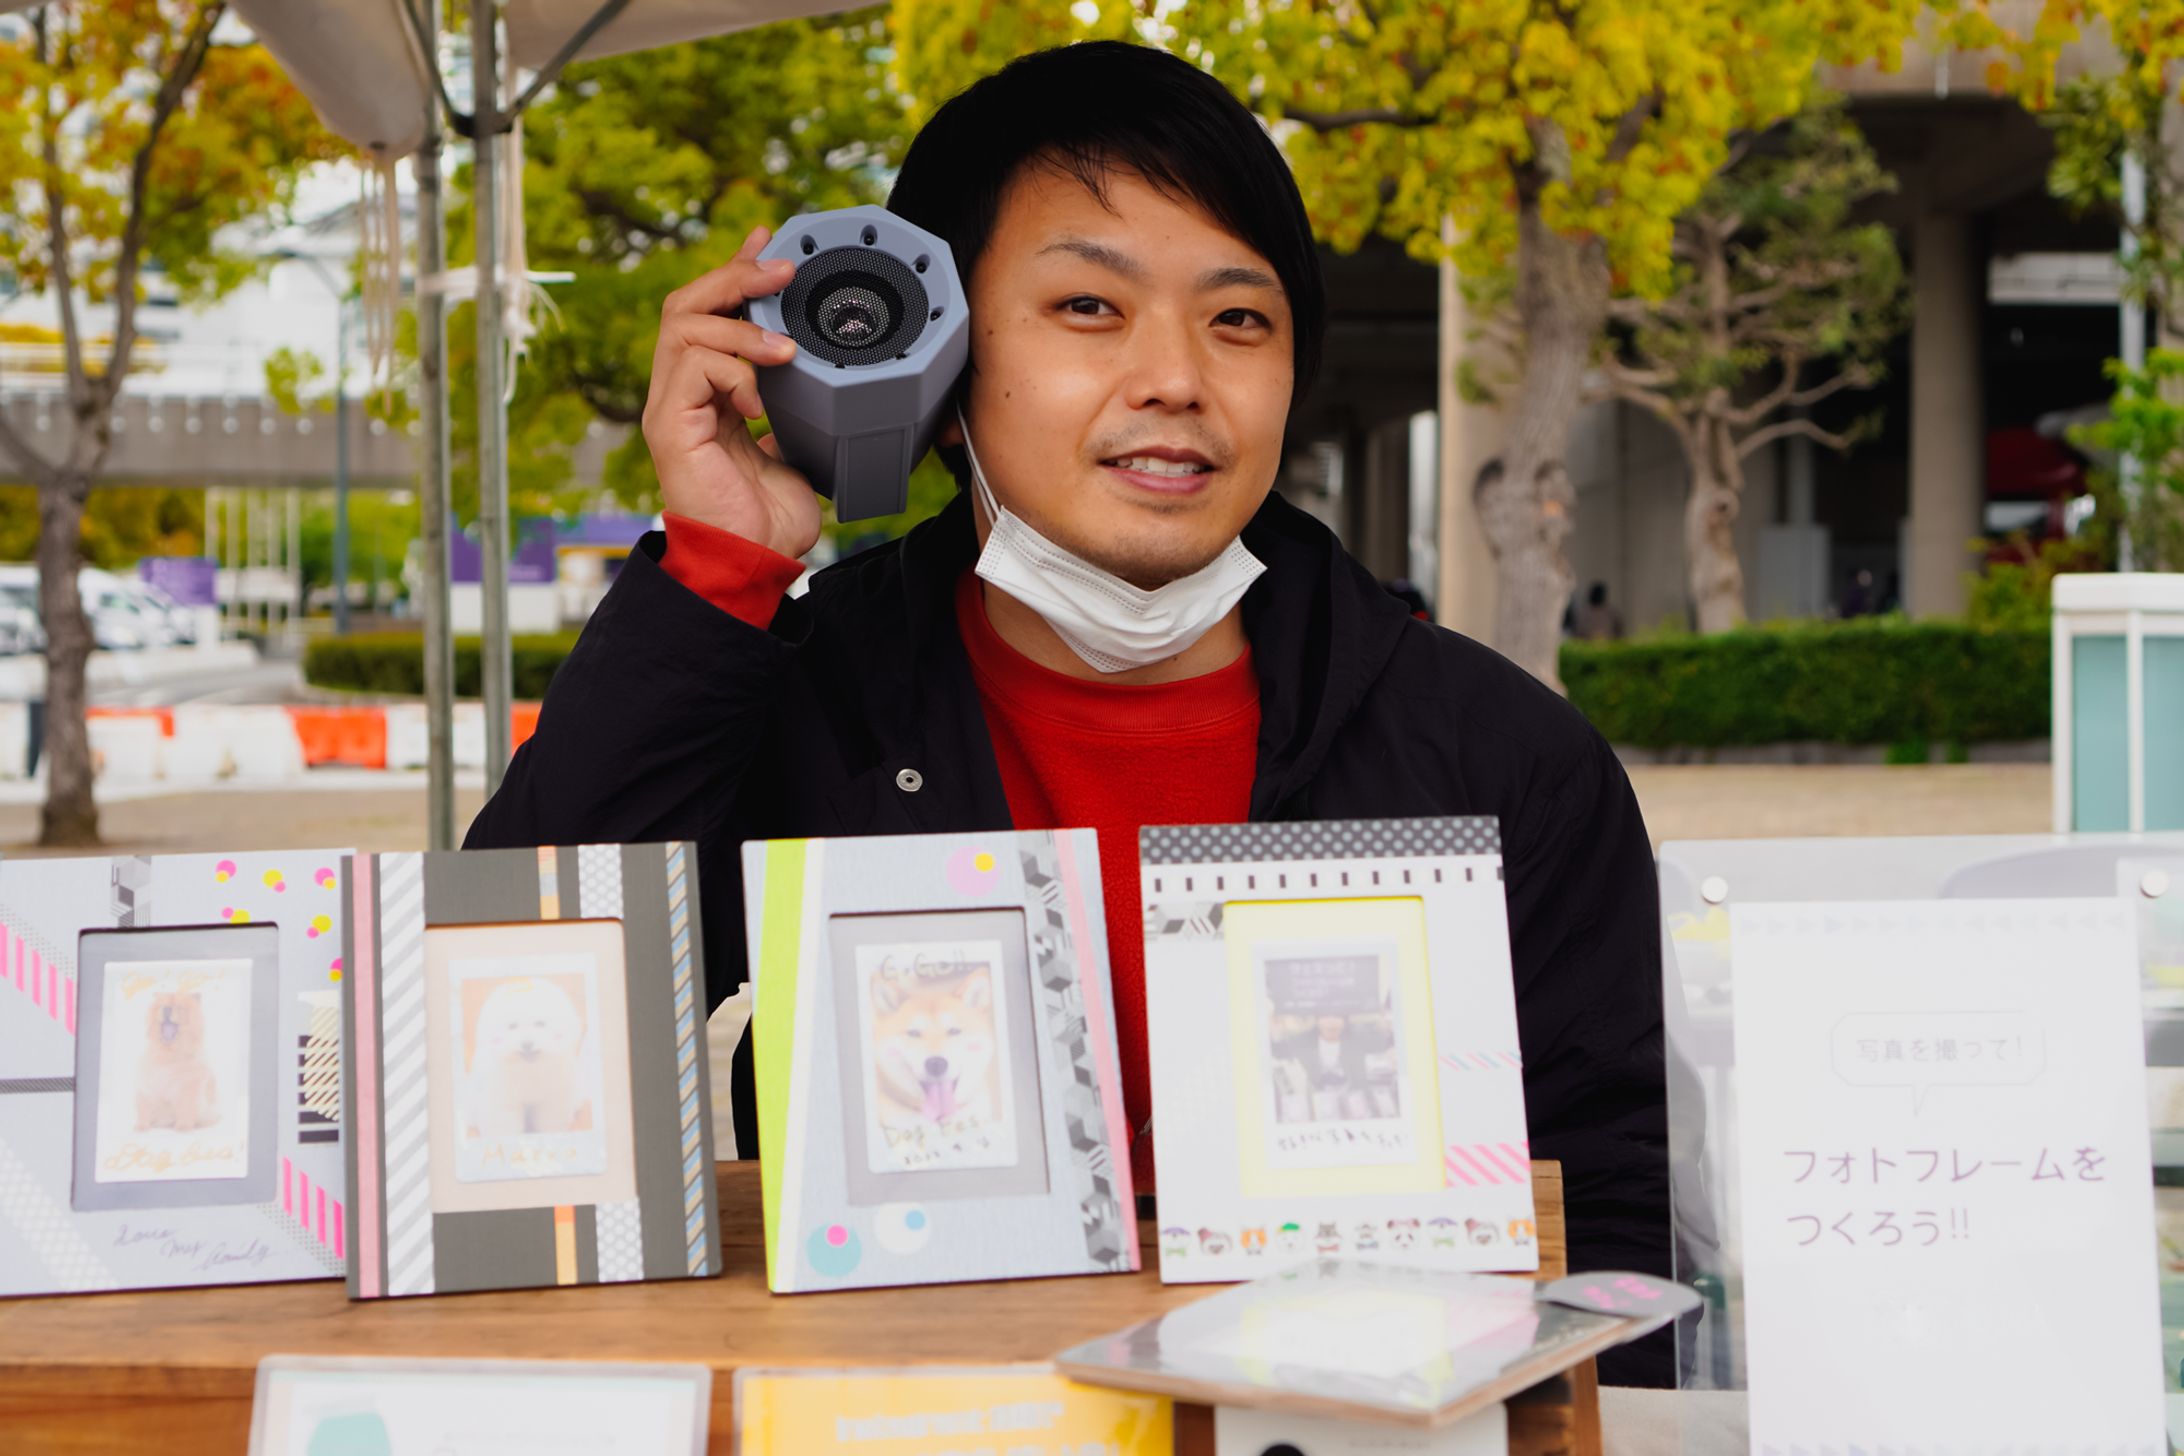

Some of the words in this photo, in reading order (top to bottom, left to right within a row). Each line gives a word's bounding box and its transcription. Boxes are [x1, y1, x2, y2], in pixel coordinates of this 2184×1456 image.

[1783, 1146, 2107, 1184] フォトフレームを
[1786, 1208, 1971, 1246] つくろう!!
